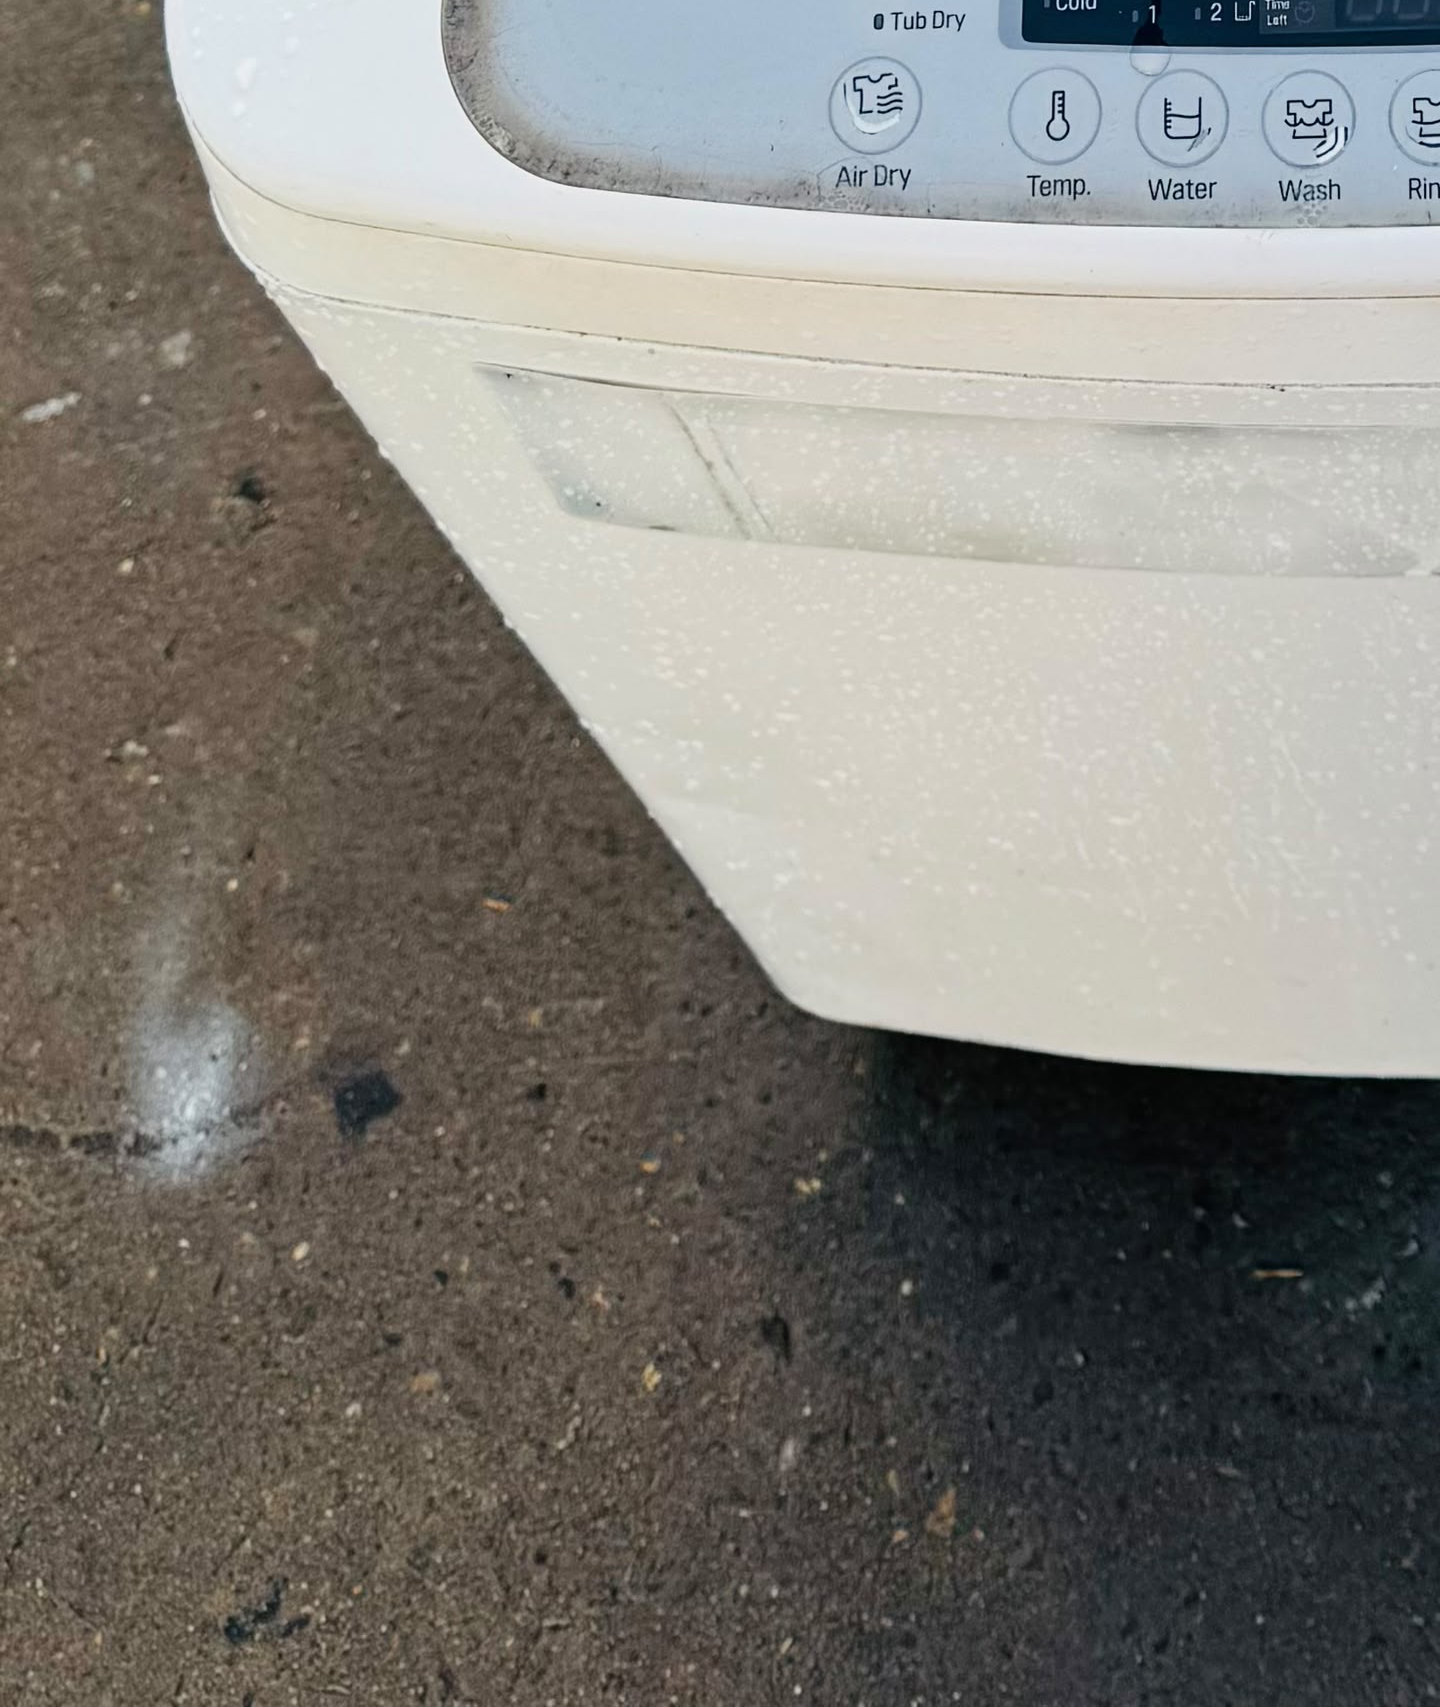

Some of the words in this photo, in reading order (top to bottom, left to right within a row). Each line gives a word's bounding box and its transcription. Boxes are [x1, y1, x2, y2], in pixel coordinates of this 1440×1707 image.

[890, 11, 927, 32] Tub
[932, 10, 966, 33] Dry
[1149, 5, 1156, 24] 1
[1209, 2, 1222, 22] 2
[835, 165, 869, 188] Air
[873, 164, 912, 191] Dry
[1027, 174, 1092, 198] Temp.
[1148, 178, 1218, 201] Water
[1278, 179, 1342, 202] Wash
